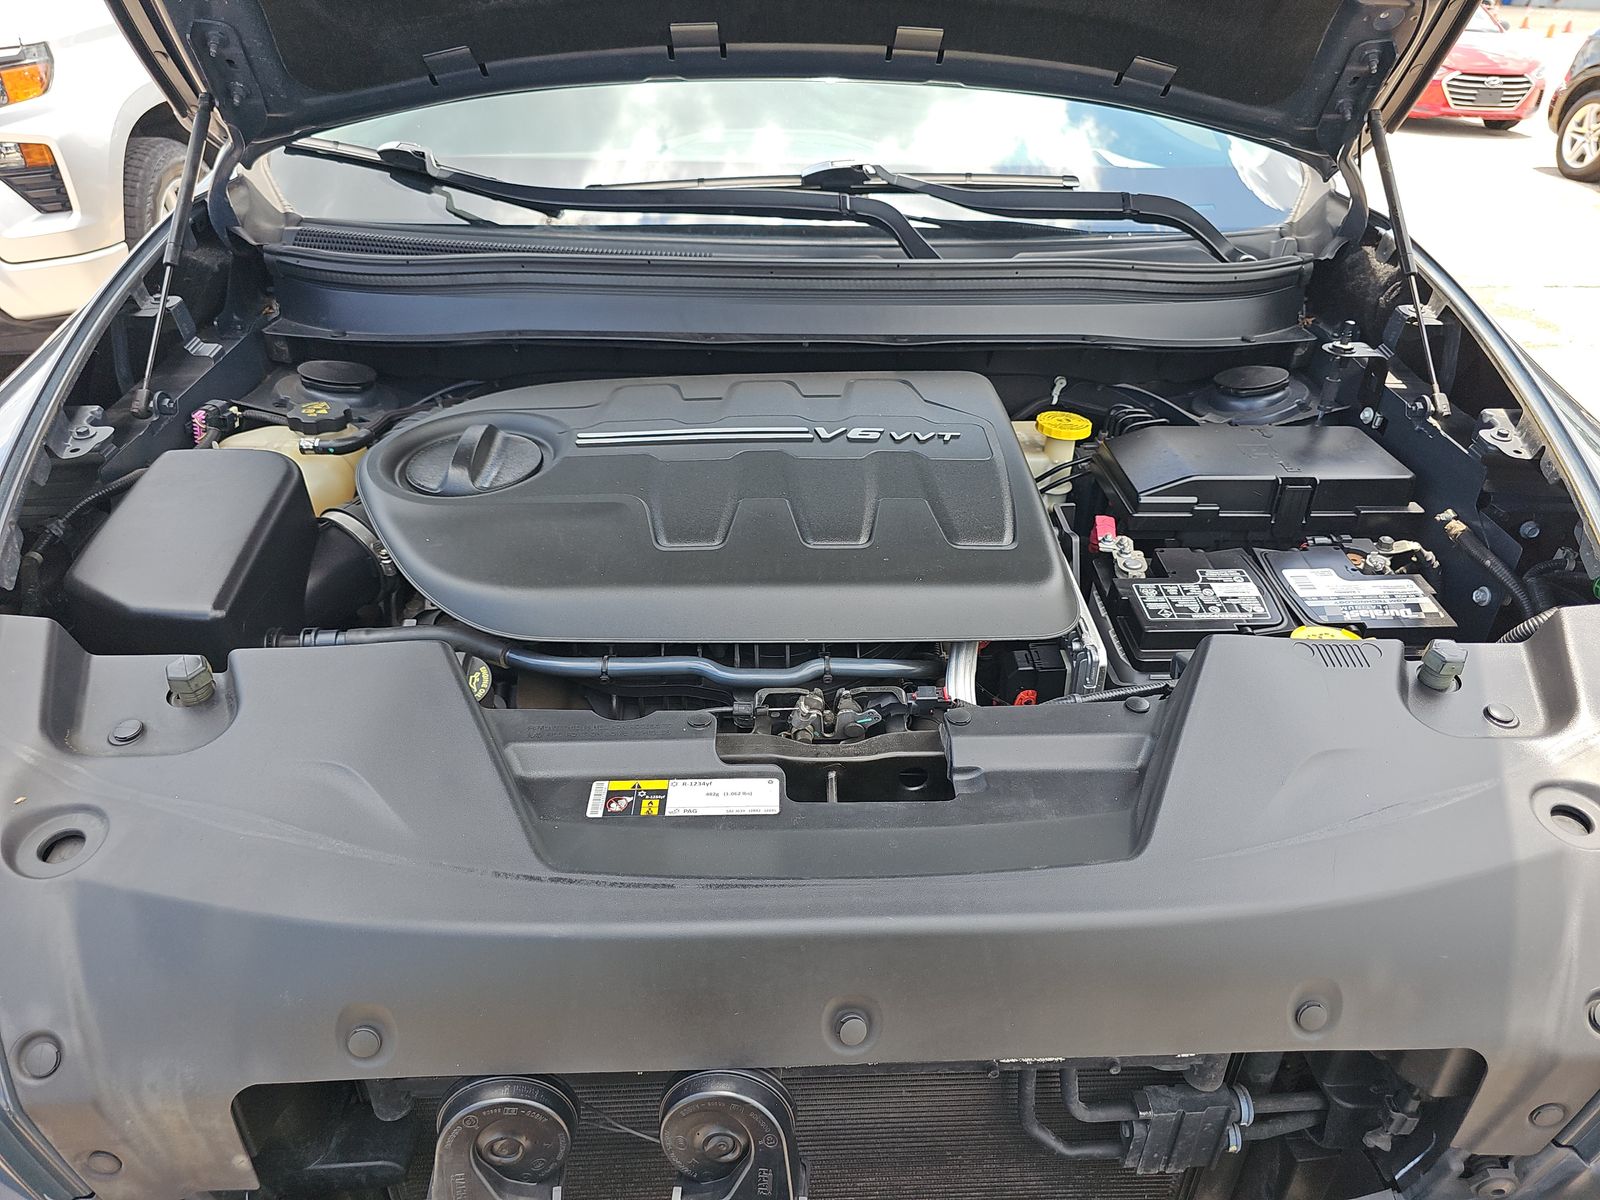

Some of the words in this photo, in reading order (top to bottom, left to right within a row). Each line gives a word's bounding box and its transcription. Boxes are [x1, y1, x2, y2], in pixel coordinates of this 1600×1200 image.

[814, 427, 884, 442] V6
[889, 431, 961, 444] VVT
[1343, 608, 1418, 620] Duralast
[474, 688, 486, 698] OIL
